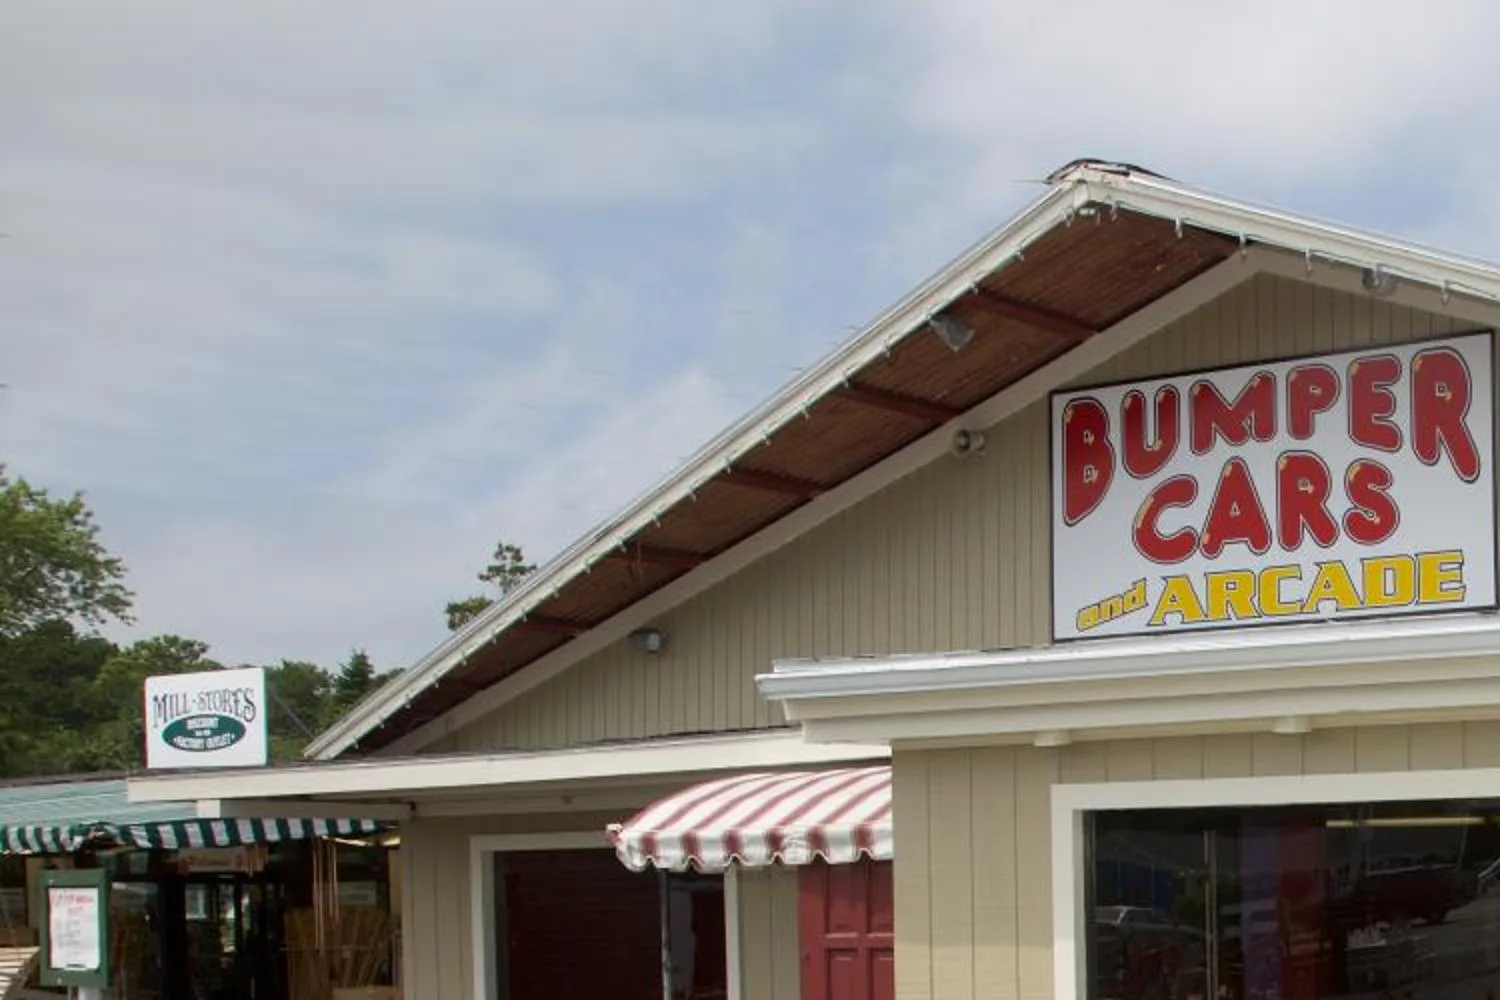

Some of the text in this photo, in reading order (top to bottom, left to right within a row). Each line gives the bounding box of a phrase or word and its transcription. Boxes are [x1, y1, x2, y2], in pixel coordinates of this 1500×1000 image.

[1062, 346, 1481, 528] BUMPER
[1132, 450, 1400, 565] CARS
[1075, 549, 1467, 632] and ARCADE
[197, 687, 256, 723] STORES
